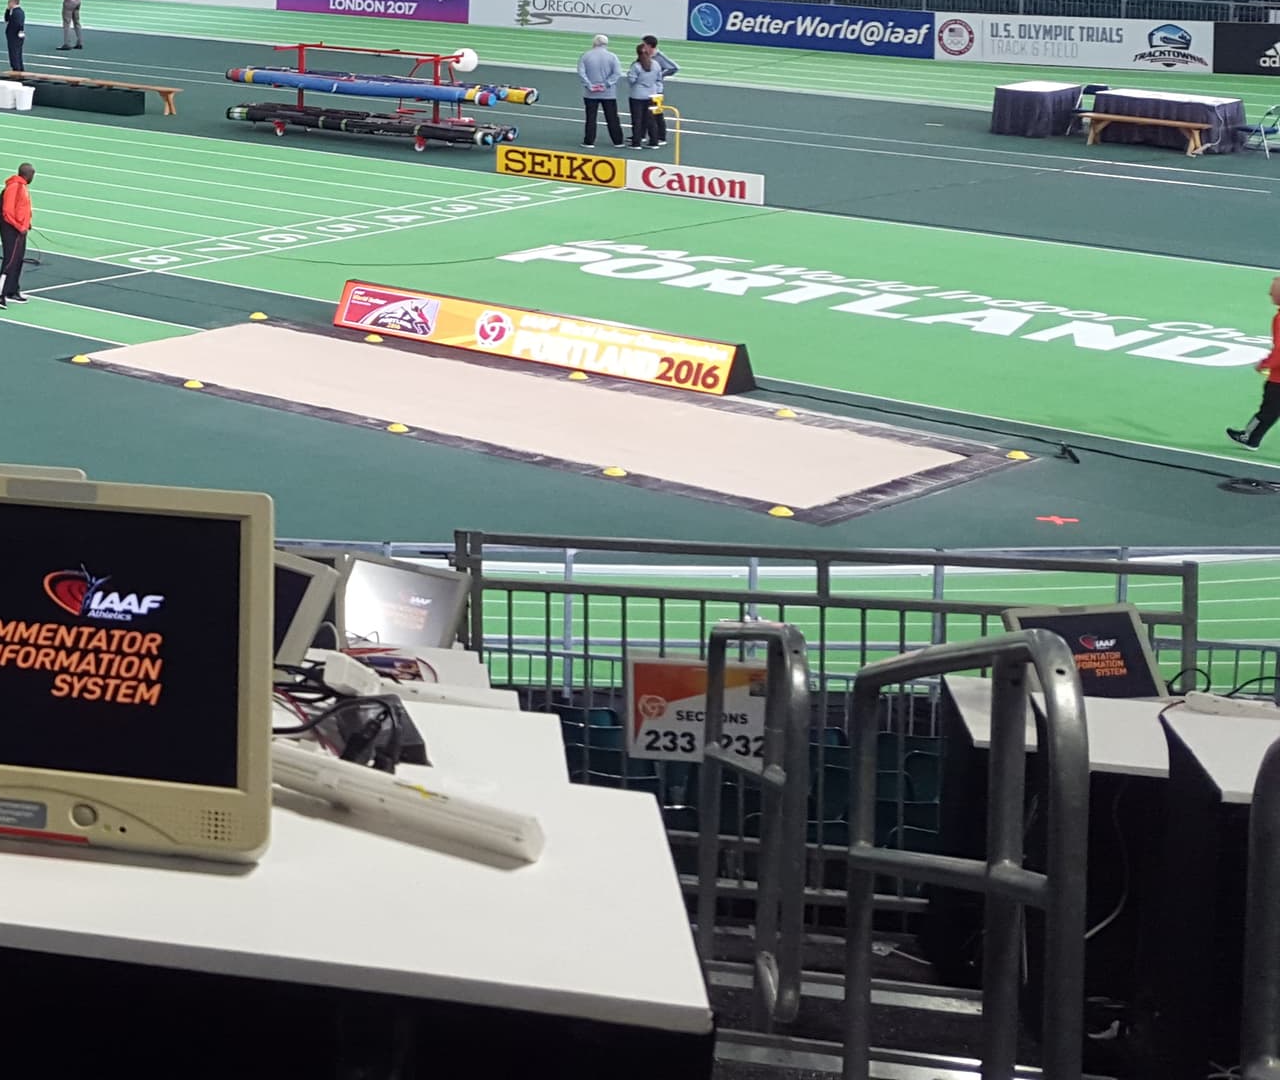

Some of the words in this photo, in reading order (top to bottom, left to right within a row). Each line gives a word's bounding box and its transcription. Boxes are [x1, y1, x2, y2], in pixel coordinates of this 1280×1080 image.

[386, 0, 418, 16] 2017
[990, 24, 1015, 39] U.S.
[1017, 25, 1075, 42] OLYMPIC
[1078, 27, 1123, 44] TRIALS
[990, 39, 1028, 56] TRACK
[1043, 41, 1079, 58] FIELD
[504, 148, 617, 184] SEIKO
[641, 165, 747, 200] Canon
[495, 244, 1272, 367] PORTLAND
[924, 290, 1149, 322] Indoor
[87, 608, 133, 621] Athletics
[89, 590, 166, 616] IAAF
[50, 673, 163, 707] SYSTEM
[676, 709, 749, 725] SECONS
[644, 729, 696, 753] 233
